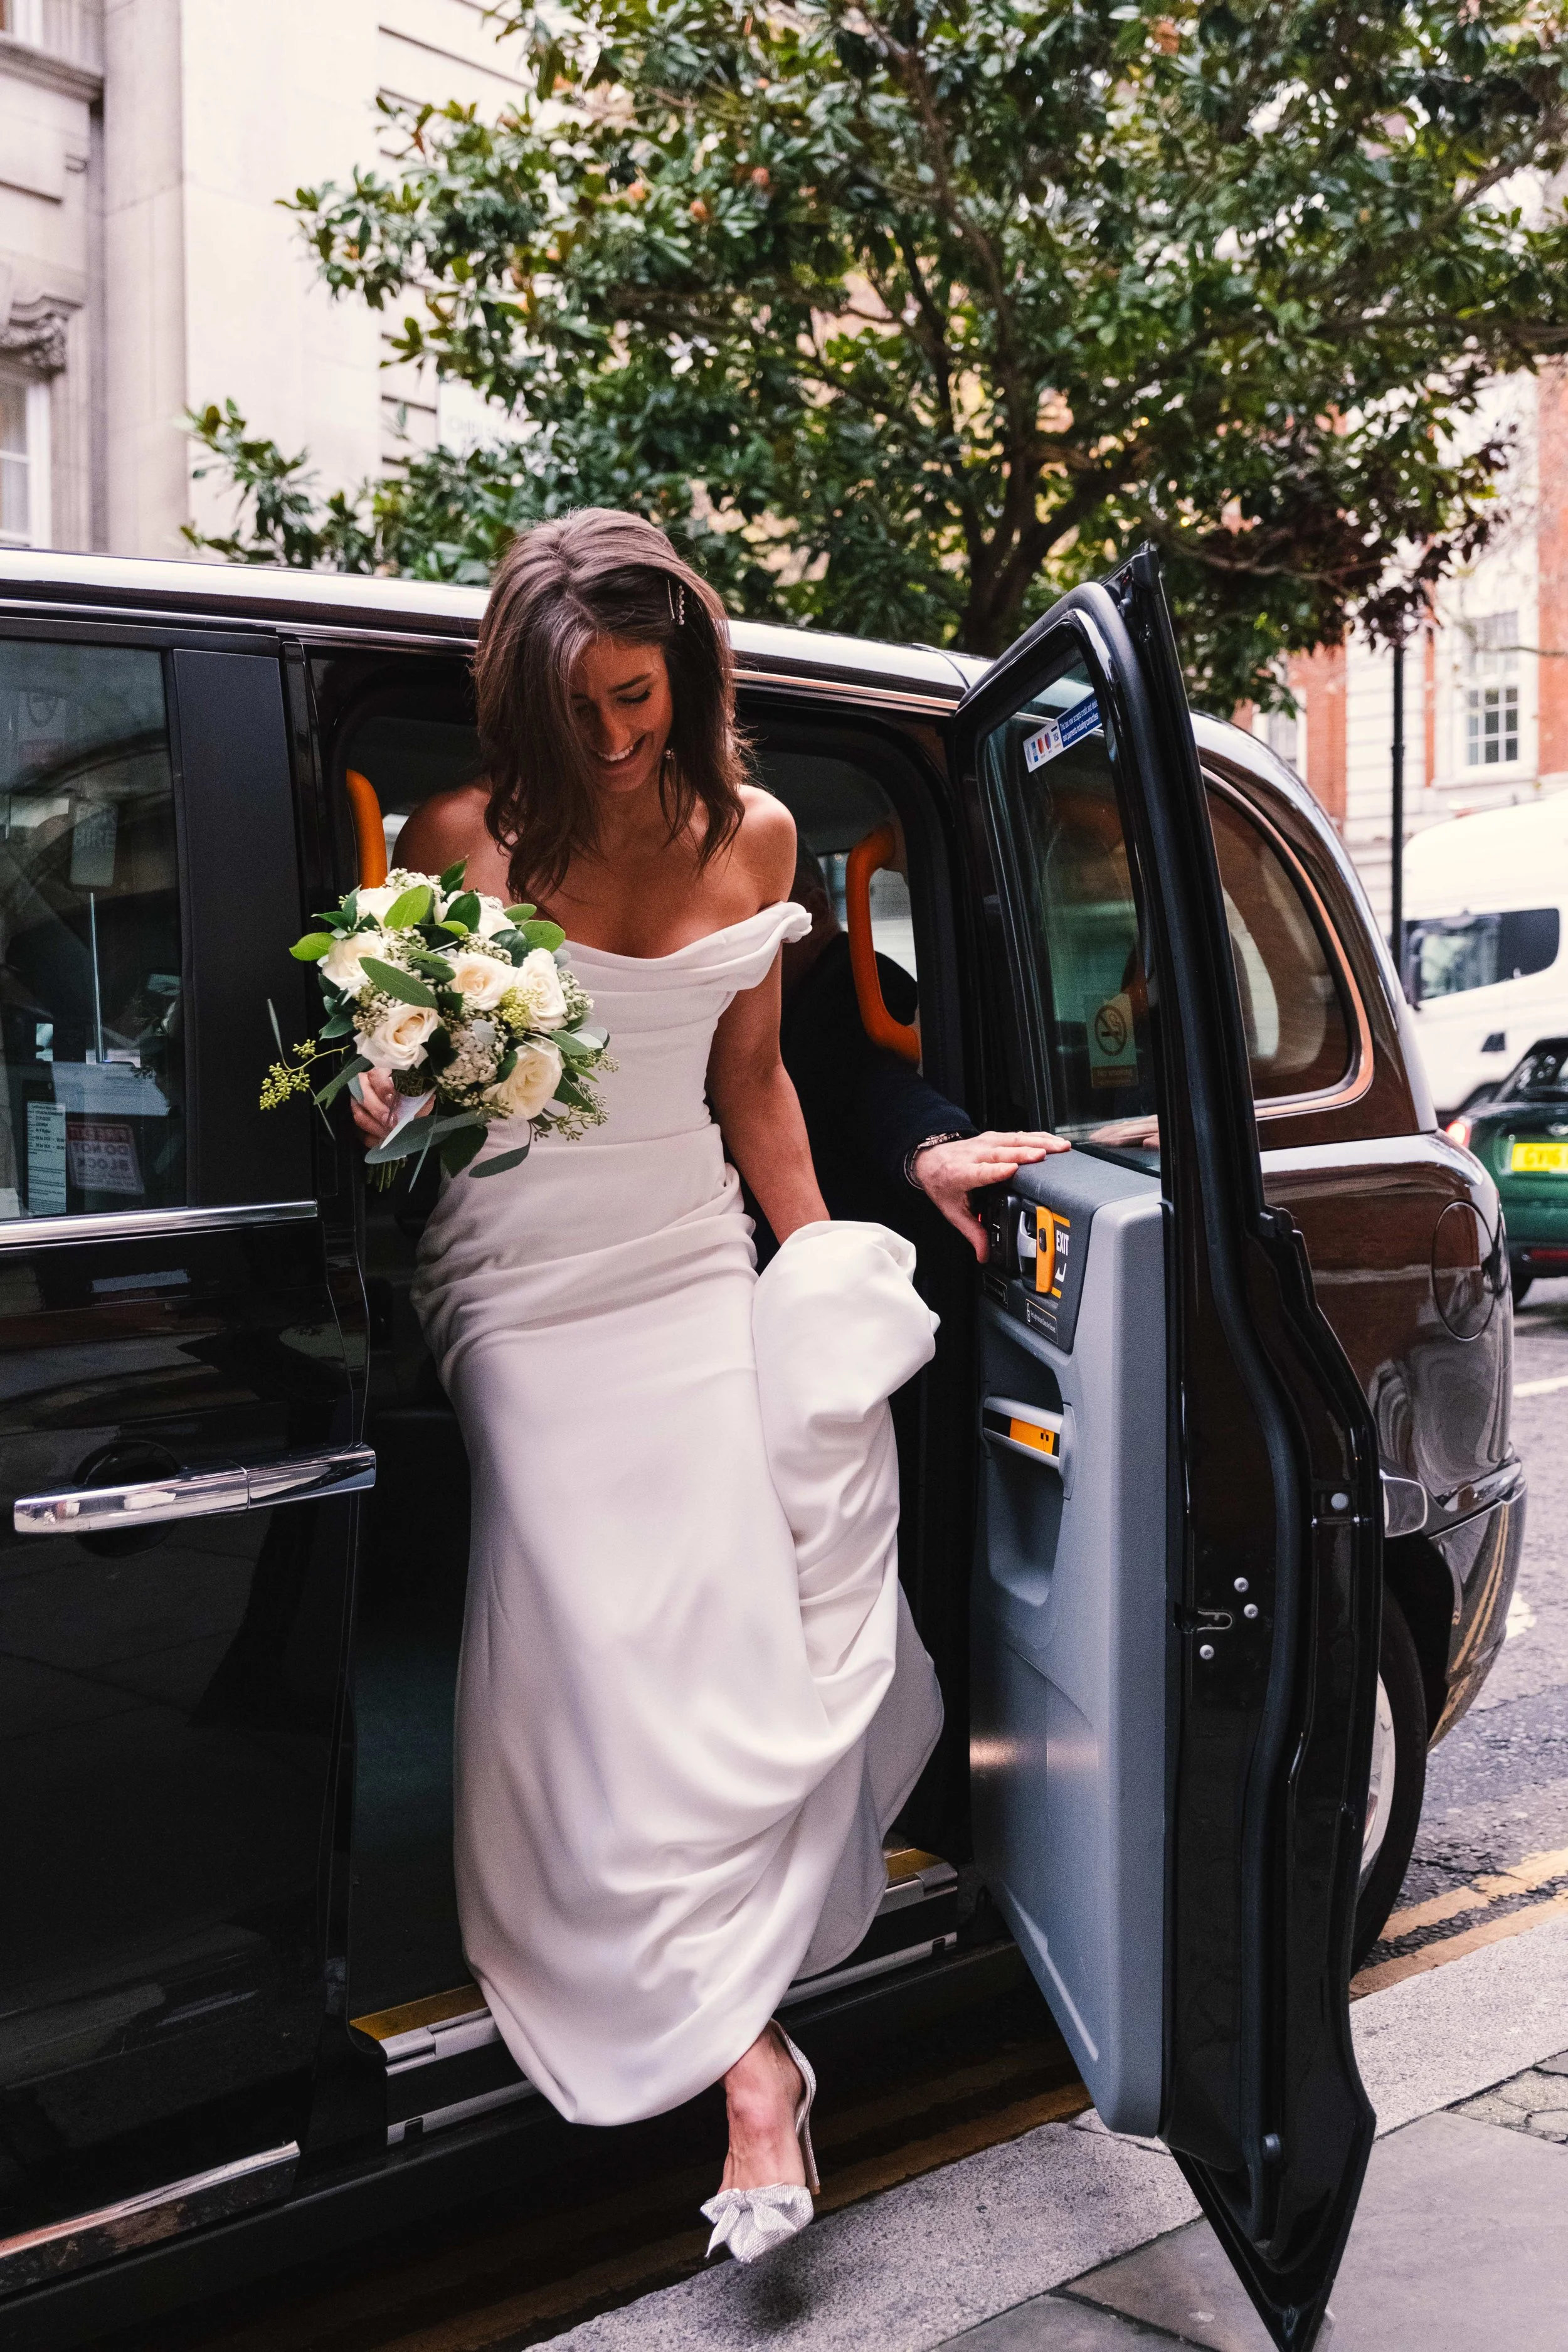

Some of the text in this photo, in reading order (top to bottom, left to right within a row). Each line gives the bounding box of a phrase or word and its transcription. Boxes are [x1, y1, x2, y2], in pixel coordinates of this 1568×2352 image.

[1067, 727, 1078, 741] payments
[1076, 720, 1087, 732] including
[1086, 713, 1099, 726] contactless
[1073, 712, 1082, 722] accepts
[73, 827, 117, 847] HIRE
[1056, 1229, 1069, 1256] EXIT
